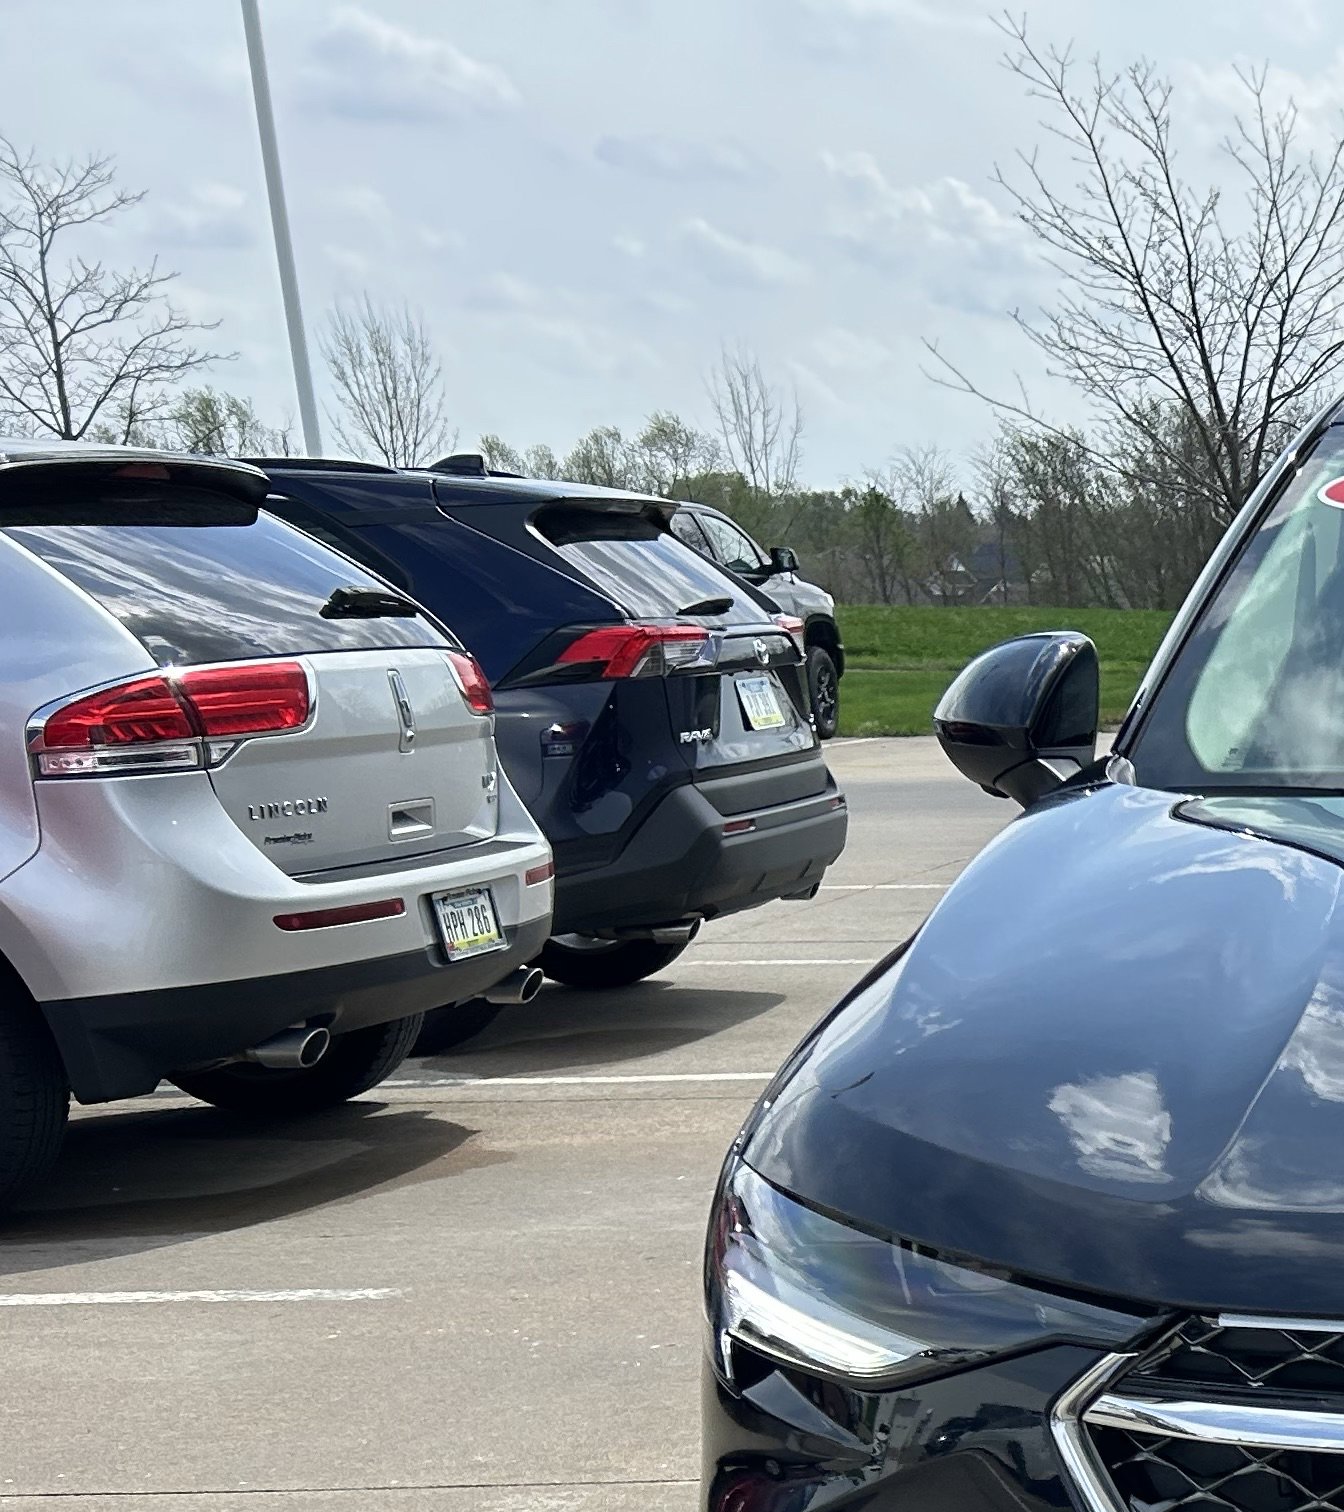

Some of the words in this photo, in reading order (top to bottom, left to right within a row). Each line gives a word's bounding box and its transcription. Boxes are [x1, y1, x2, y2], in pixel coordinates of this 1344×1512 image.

[247, 796, 328, 821] LINCOLN
[442, 909, 470, 944] HPH
[467, 904, 491, 936] 286
